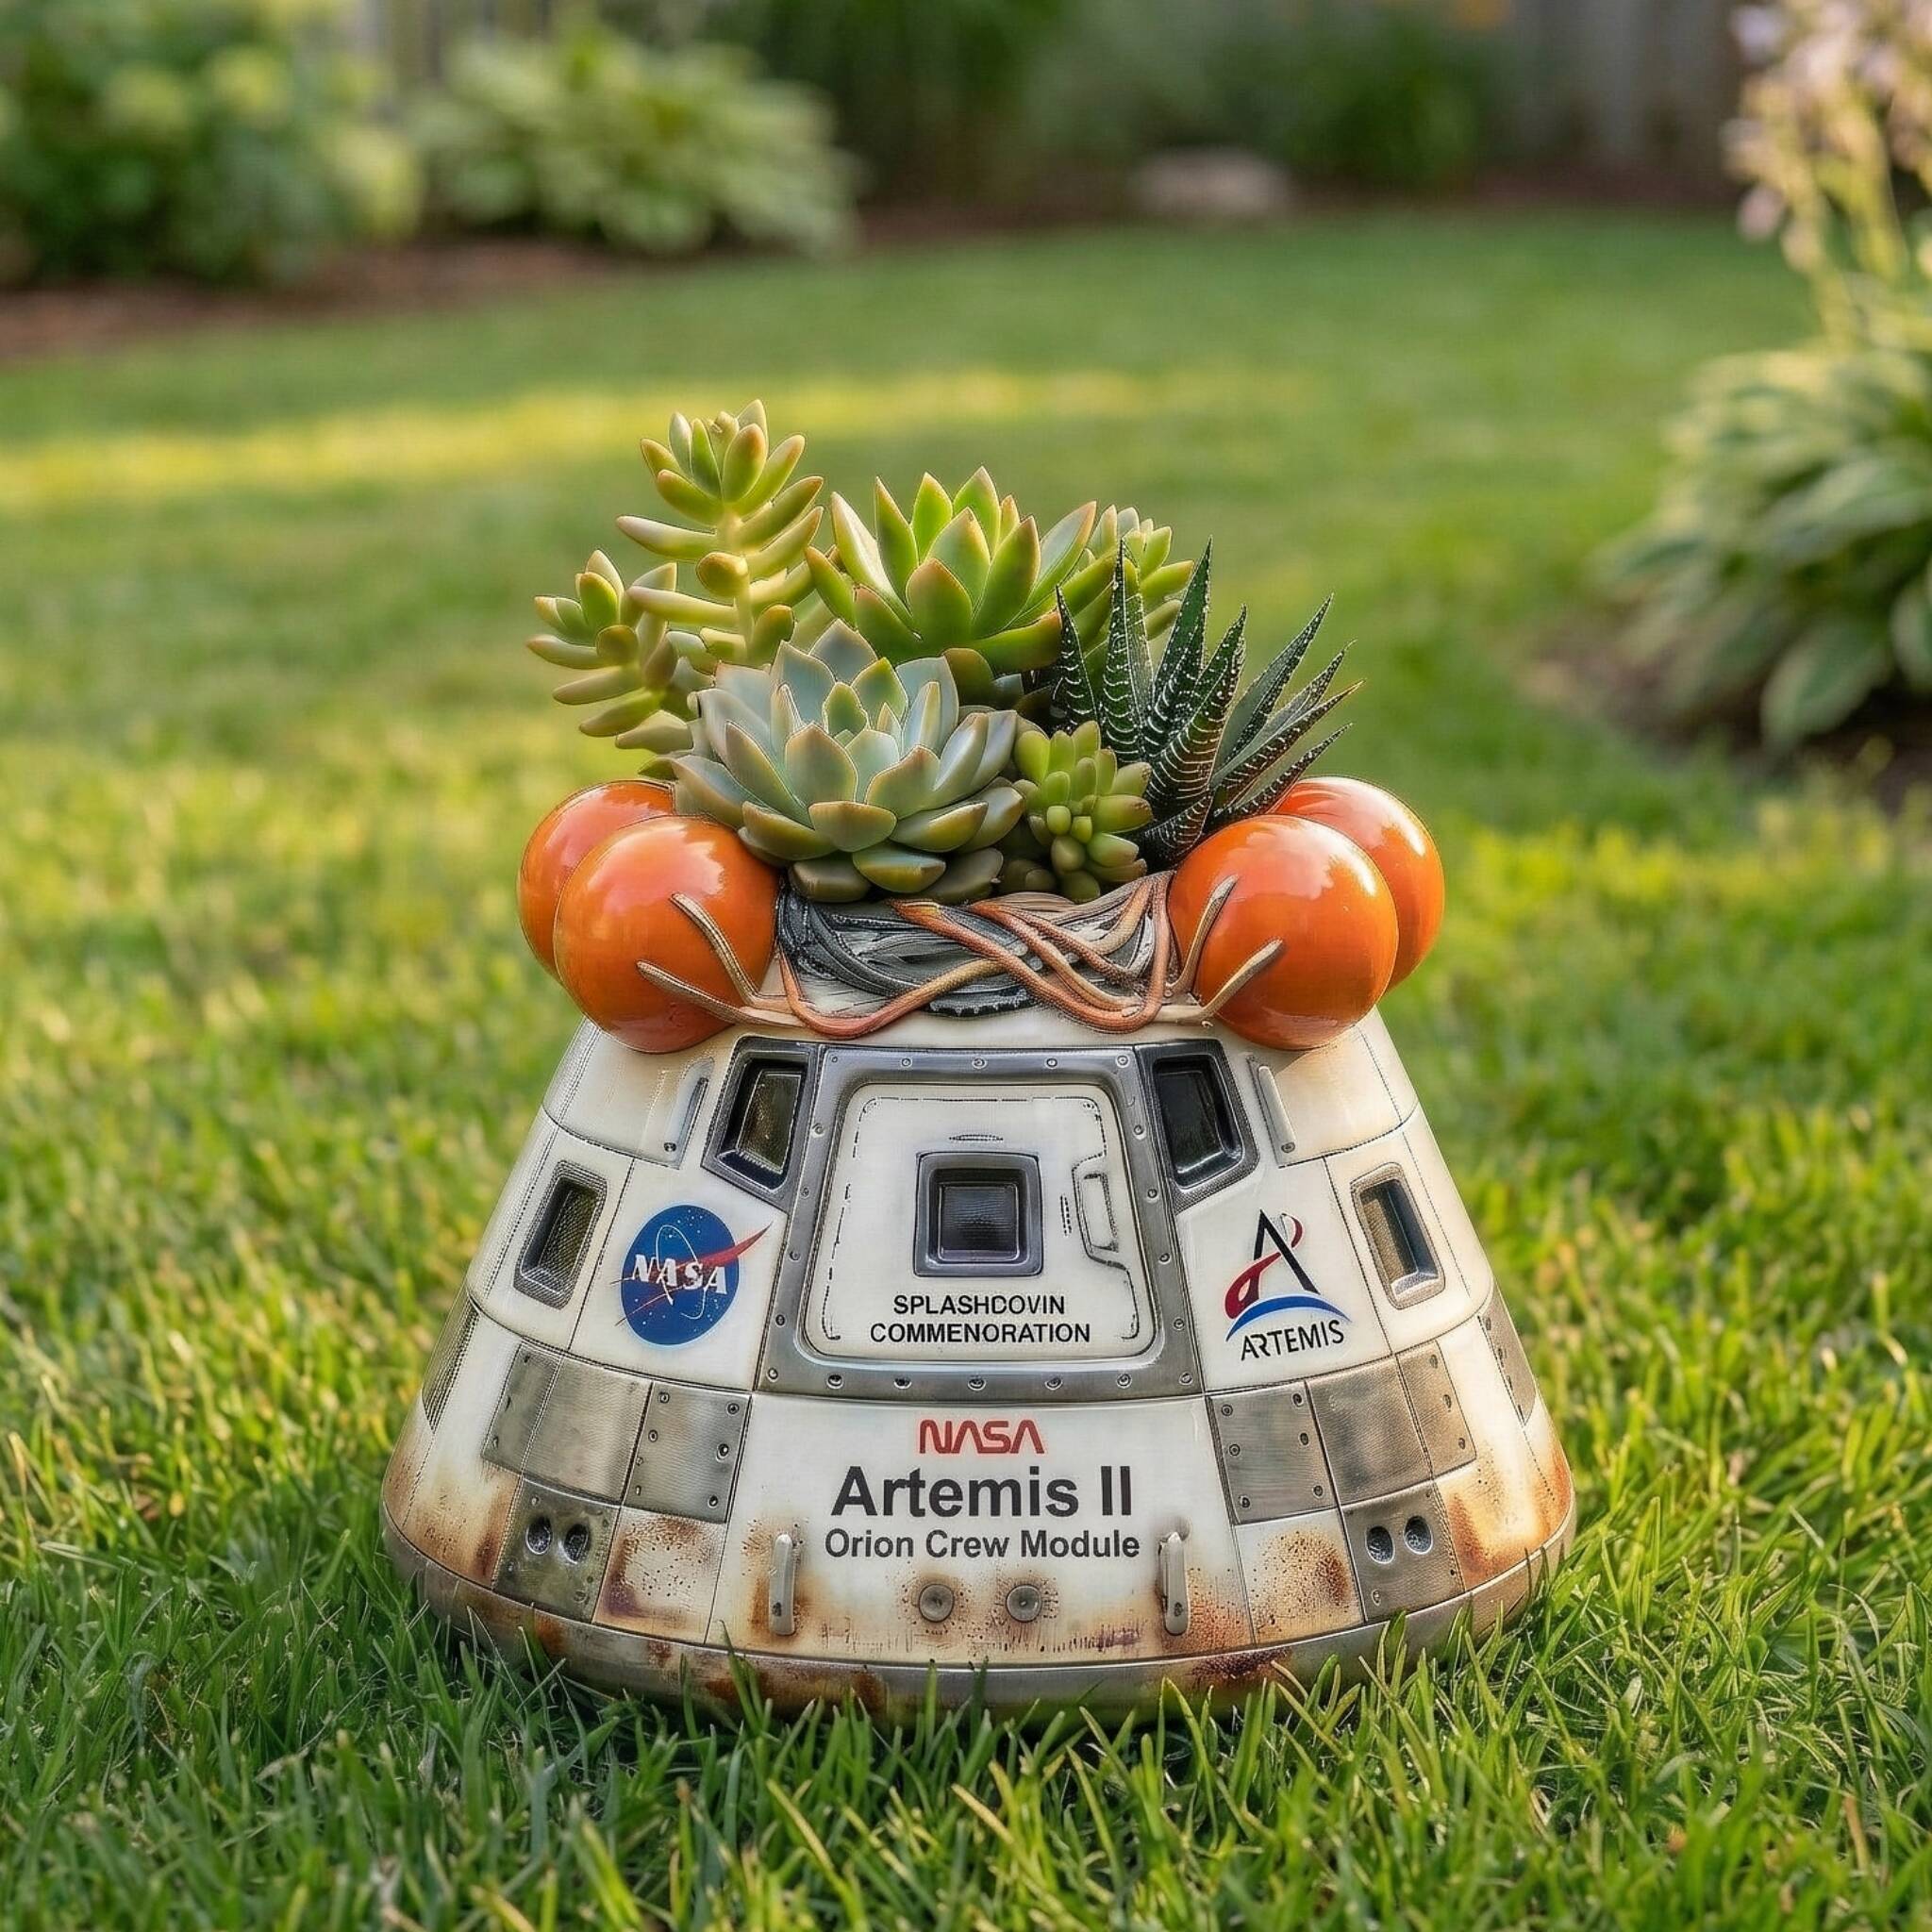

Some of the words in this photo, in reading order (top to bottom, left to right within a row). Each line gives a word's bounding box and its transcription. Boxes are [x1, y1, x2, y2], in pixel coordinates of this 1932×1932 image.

[632, 1254, 726, 1294] NASA
[870, 1323, 1091, 1343] COMMENORATION
[1241, 1320, 1344, 1360] ARTEMIS
[919, 1419, 1044, 1454] NASA
[830, 1466, 1079, 1517] Artemis
[1100, 1465, 1132, 1516] II
[824, 1528, 914, 1558] Orion
[925, 1528, 1010, 1558] Crew
[1021, 1528, 1141, 1558] Module
